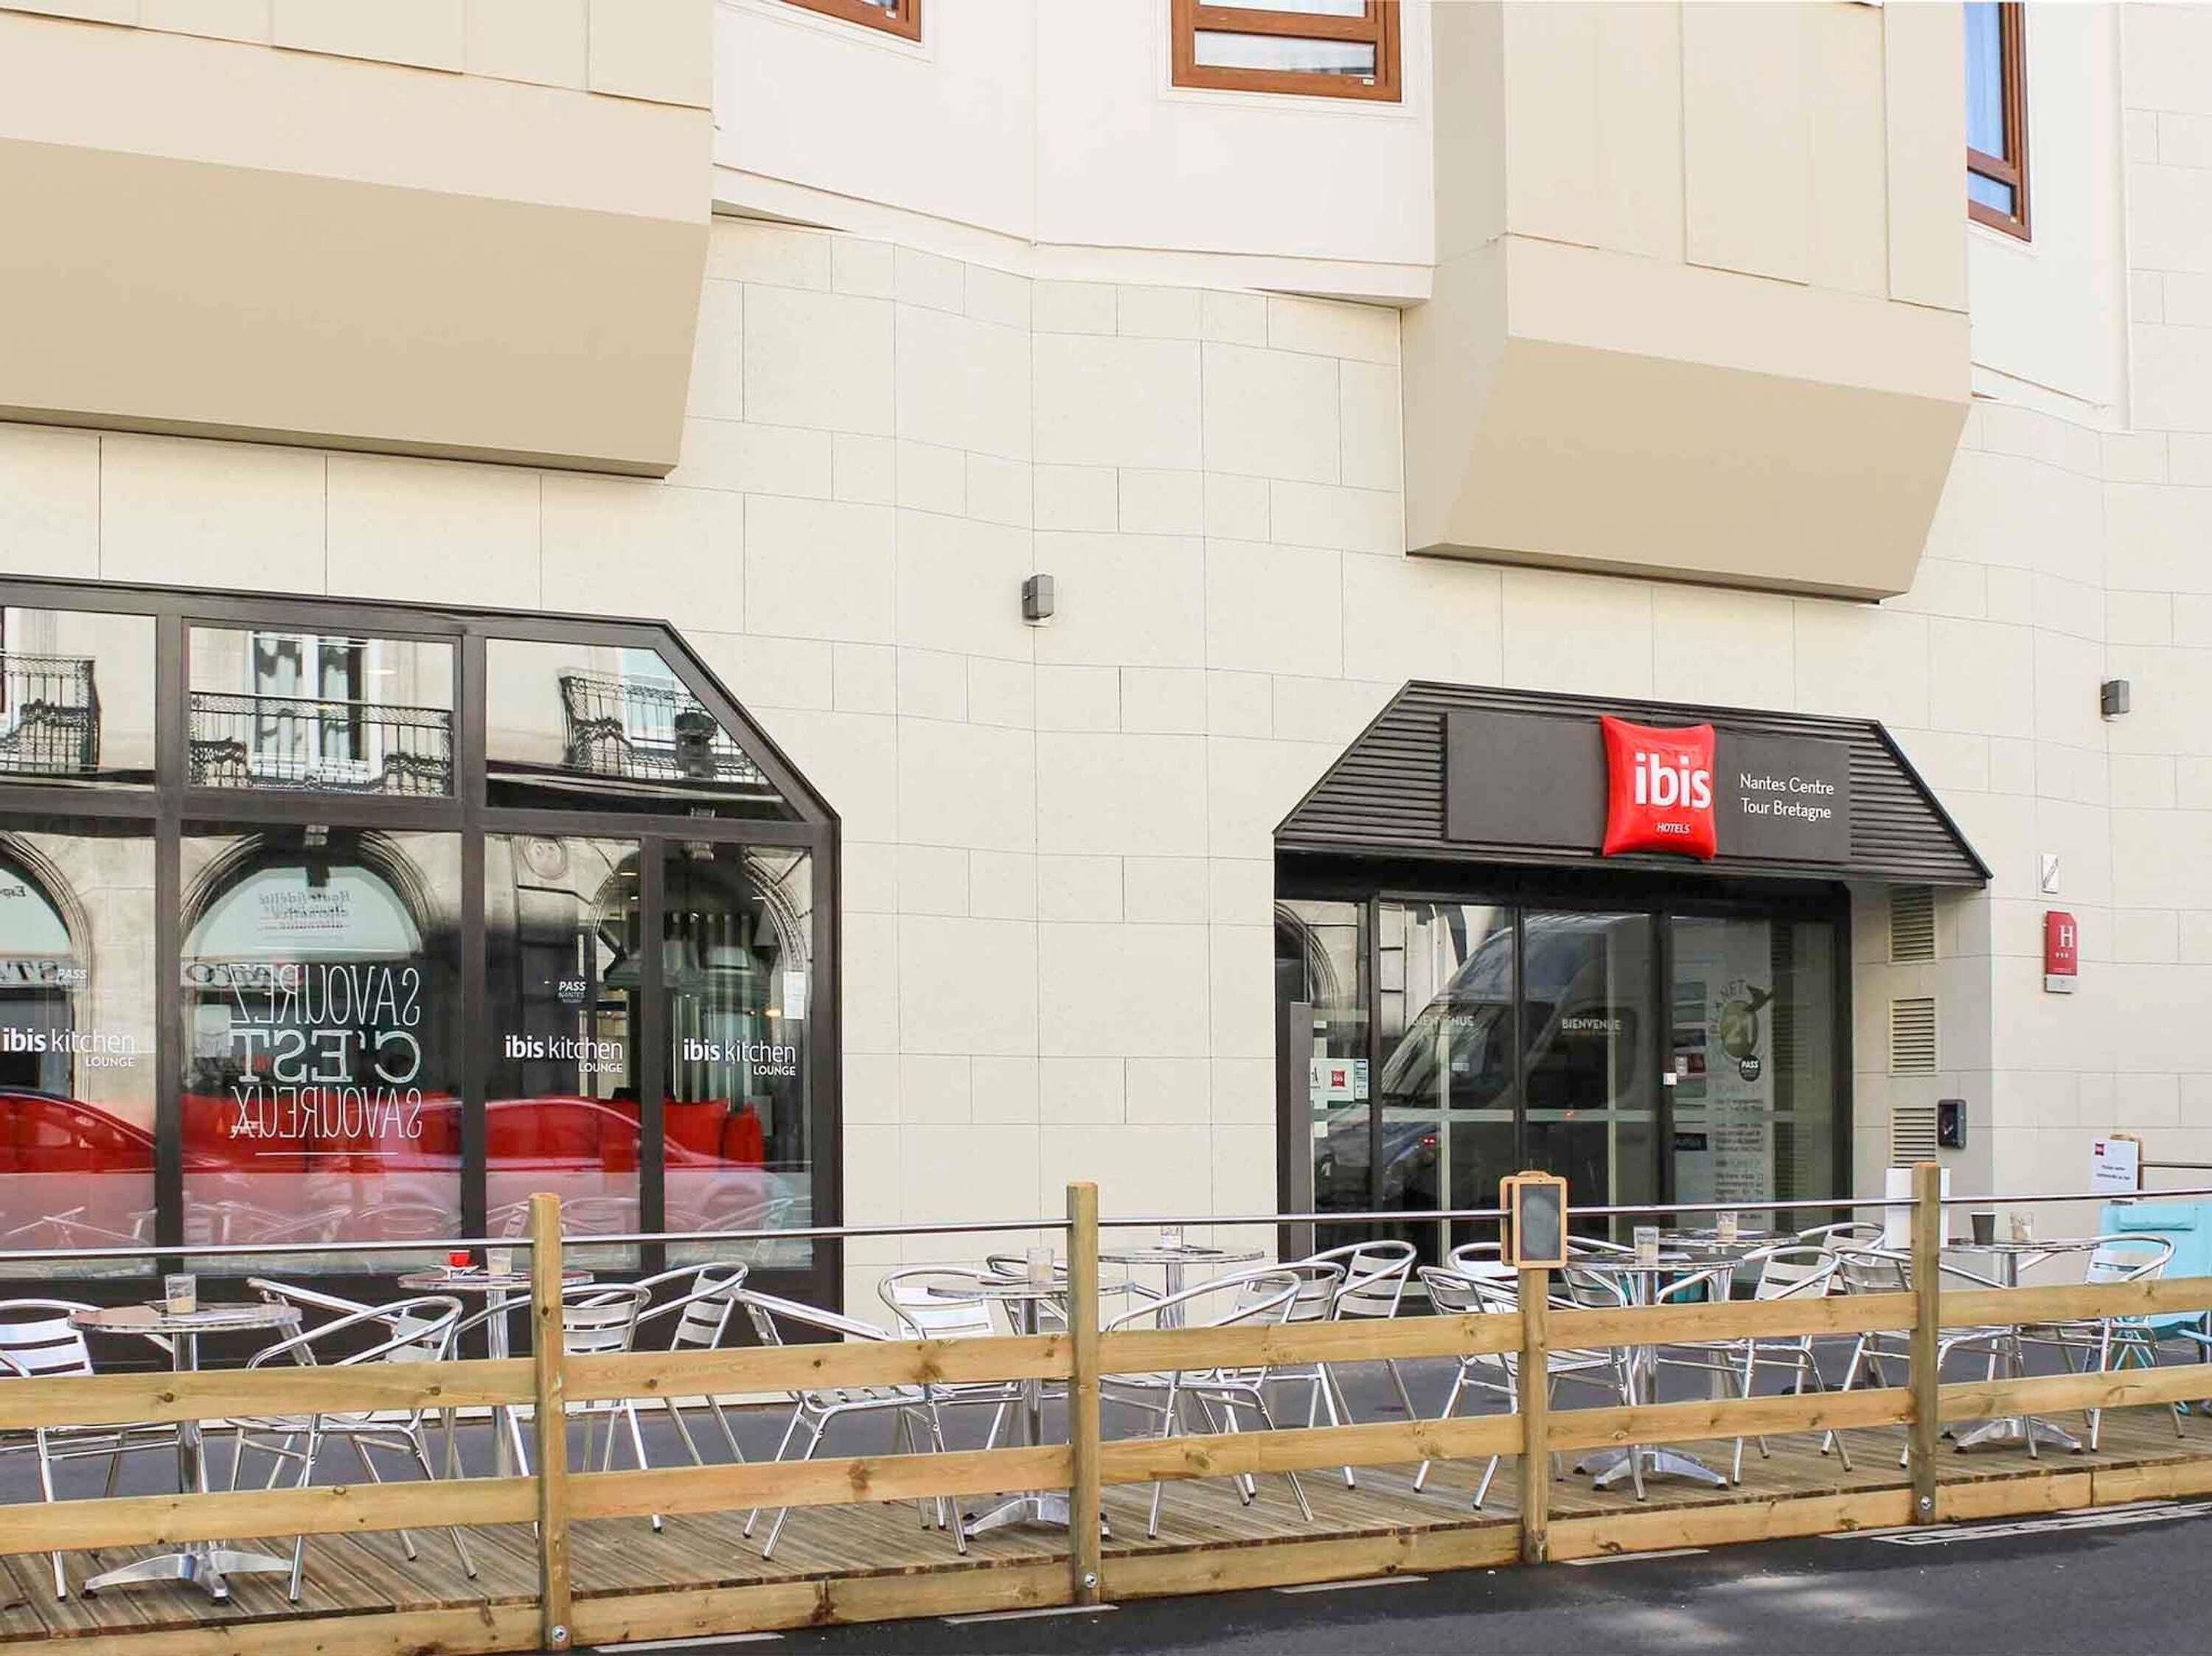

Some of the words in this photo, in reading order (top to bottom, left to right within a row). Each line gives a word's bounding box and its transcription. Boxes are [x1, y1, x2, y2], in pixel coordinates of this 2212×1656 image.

[1635, 751, 1711, 810] ibis
[1739, 773, 1787, 792] Nantes
[1790, 776, 1835, 795] Centre
[1740, 797, 1770, 814] Tour
[1773, 799, 1832, 822] Bretagne
[1656, 821, 1691, 834] HOTELS
[2059, 925, 2073, 948] H
[57, 968, 88, 979] PASS
[558, 981, 587, 991] PASS
[1561, 1017, 1623, 1030] BIENVENUE
[3, 1027, 46, 1052] ibis
[52, 1029, 135, 1054] kitchen
[504, 1034, 545, 1059] ibis
[548, 1035, 623, 1060] kitchen
[683, 1037, 721, 1062] ibis
[725, 1038, 796, 1063] kitchen
[86, 1057, 136, 1068] LOUNGE
[578, 1062, 623, 1073] LOUNGE
[1740, 1060, 1759, 1069] PASS
[753, 1065, 796, 1076] LOUNGE
